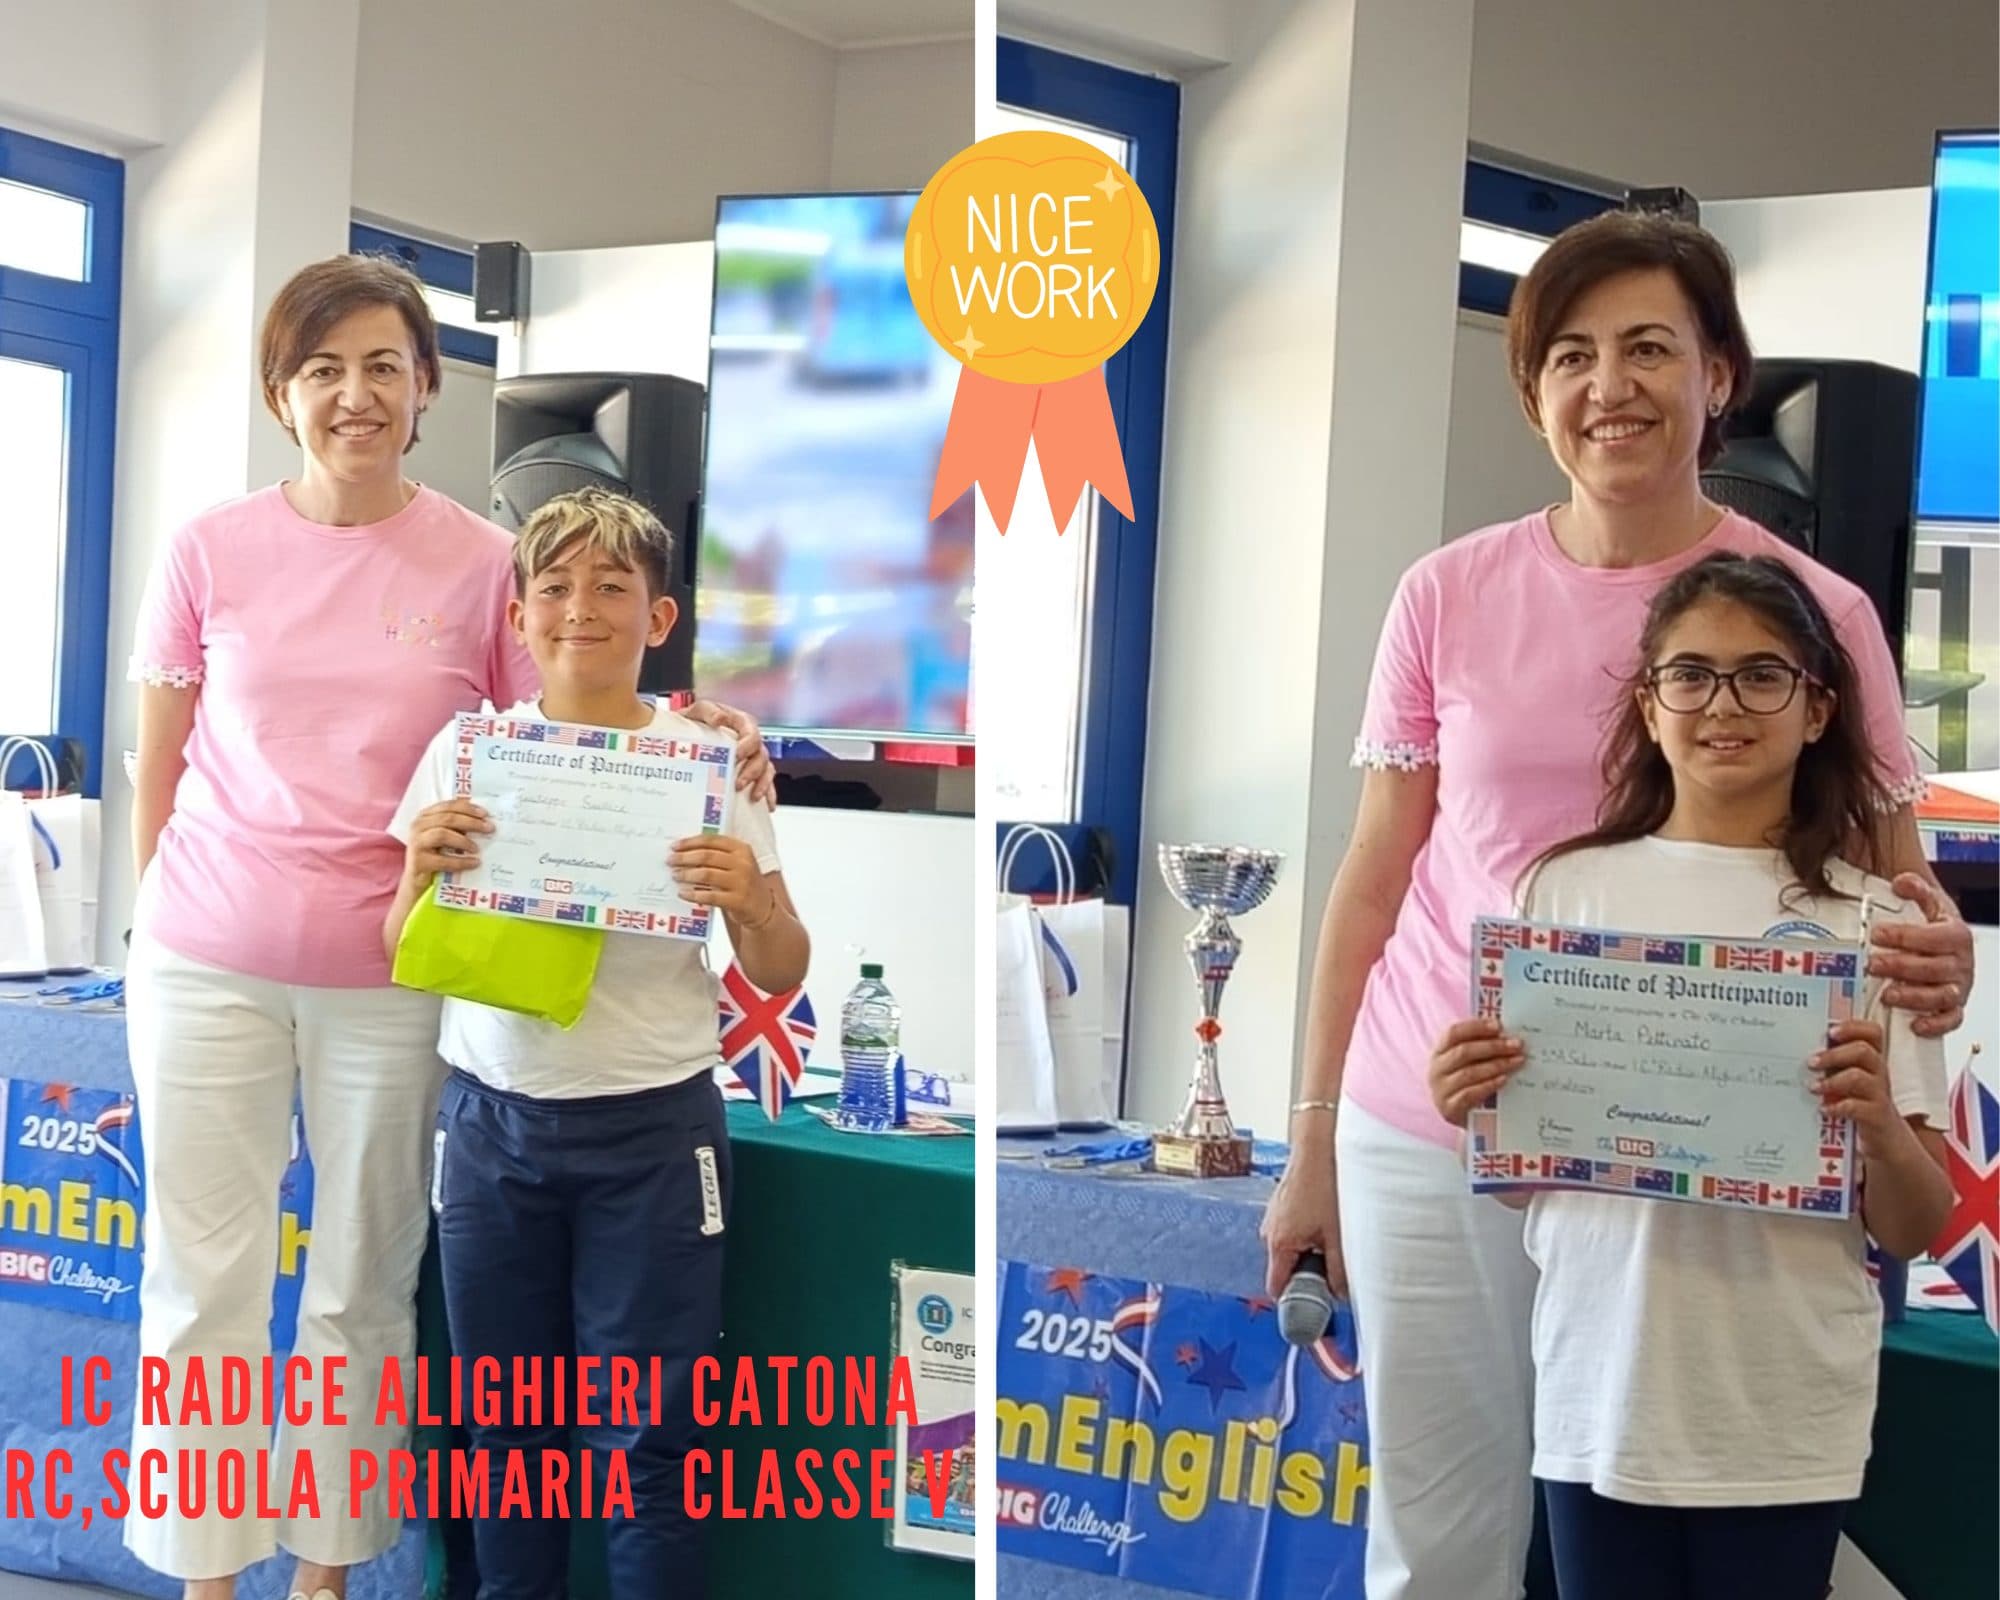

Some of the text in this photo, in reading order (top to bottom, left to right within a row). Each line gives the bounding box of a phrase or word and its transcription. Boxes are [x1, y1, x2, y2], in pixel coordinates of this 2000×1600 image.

[488, 745, 564, 769] Certificate
[569, 754, 586, 770] of
[591, 755, 694, 784] Participation
[545, 879, 572, 893] BIG
[1523, 960, 1809, 1008] Certificate of Participation
[1573, 1020, 1626, 1044] Marta
[18, 1114, 99, 1156] 2025
[1605, 1103, 1712, 1129] Congratulations!
[1618, 1138, 1653, 1156] BIG
[0, 1251, 135, 1304] BIG Challenge
[1015, 1309, 1116, 1362] 2025
[1039, 1491, 1147, 1557] Challenge
